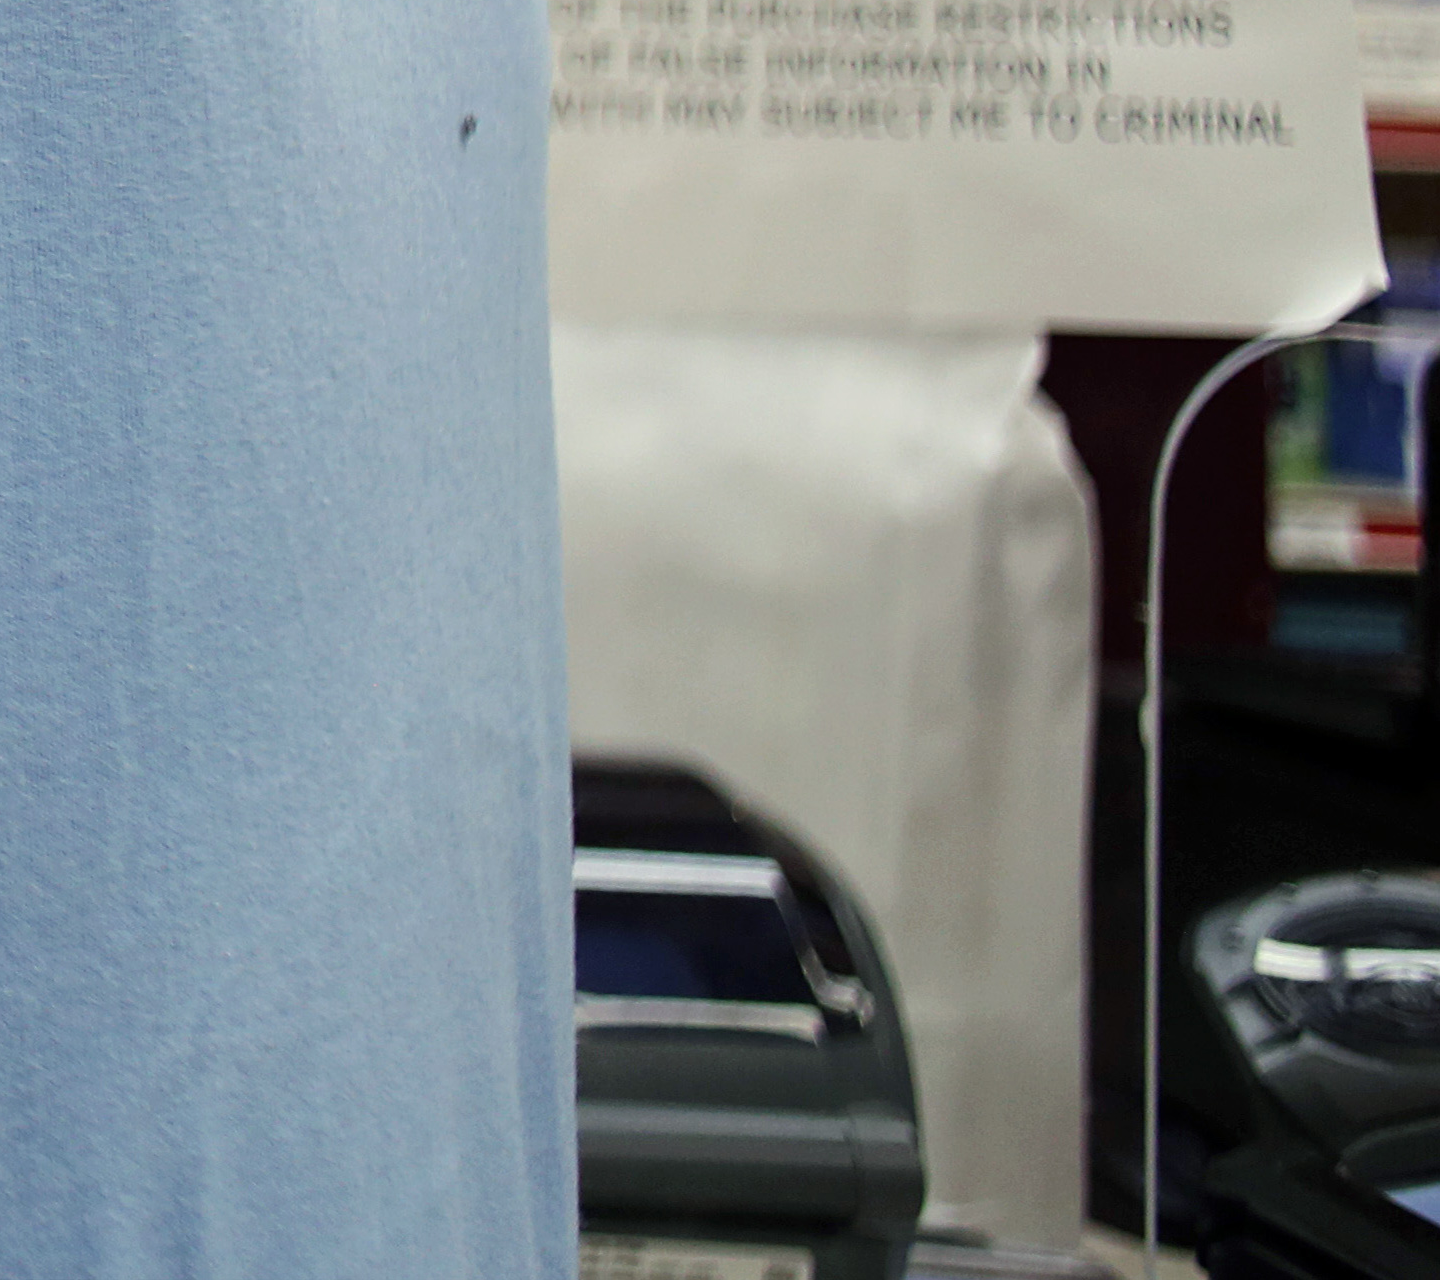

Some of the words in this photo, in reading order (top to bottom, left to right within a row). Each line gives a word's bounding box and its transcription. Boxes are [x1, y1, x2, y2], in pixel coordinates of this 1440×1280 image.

[763, 40, 1052, 89] INFORMATION
[1065, 47, 1113, 91] IN
[761, 90, 938, 134] SUBJECT
[950, 95, 1016, 136] ME
[1029, 97, 1085, 139] TO
[1094, 98, 1297, 144] CRIMINAL
